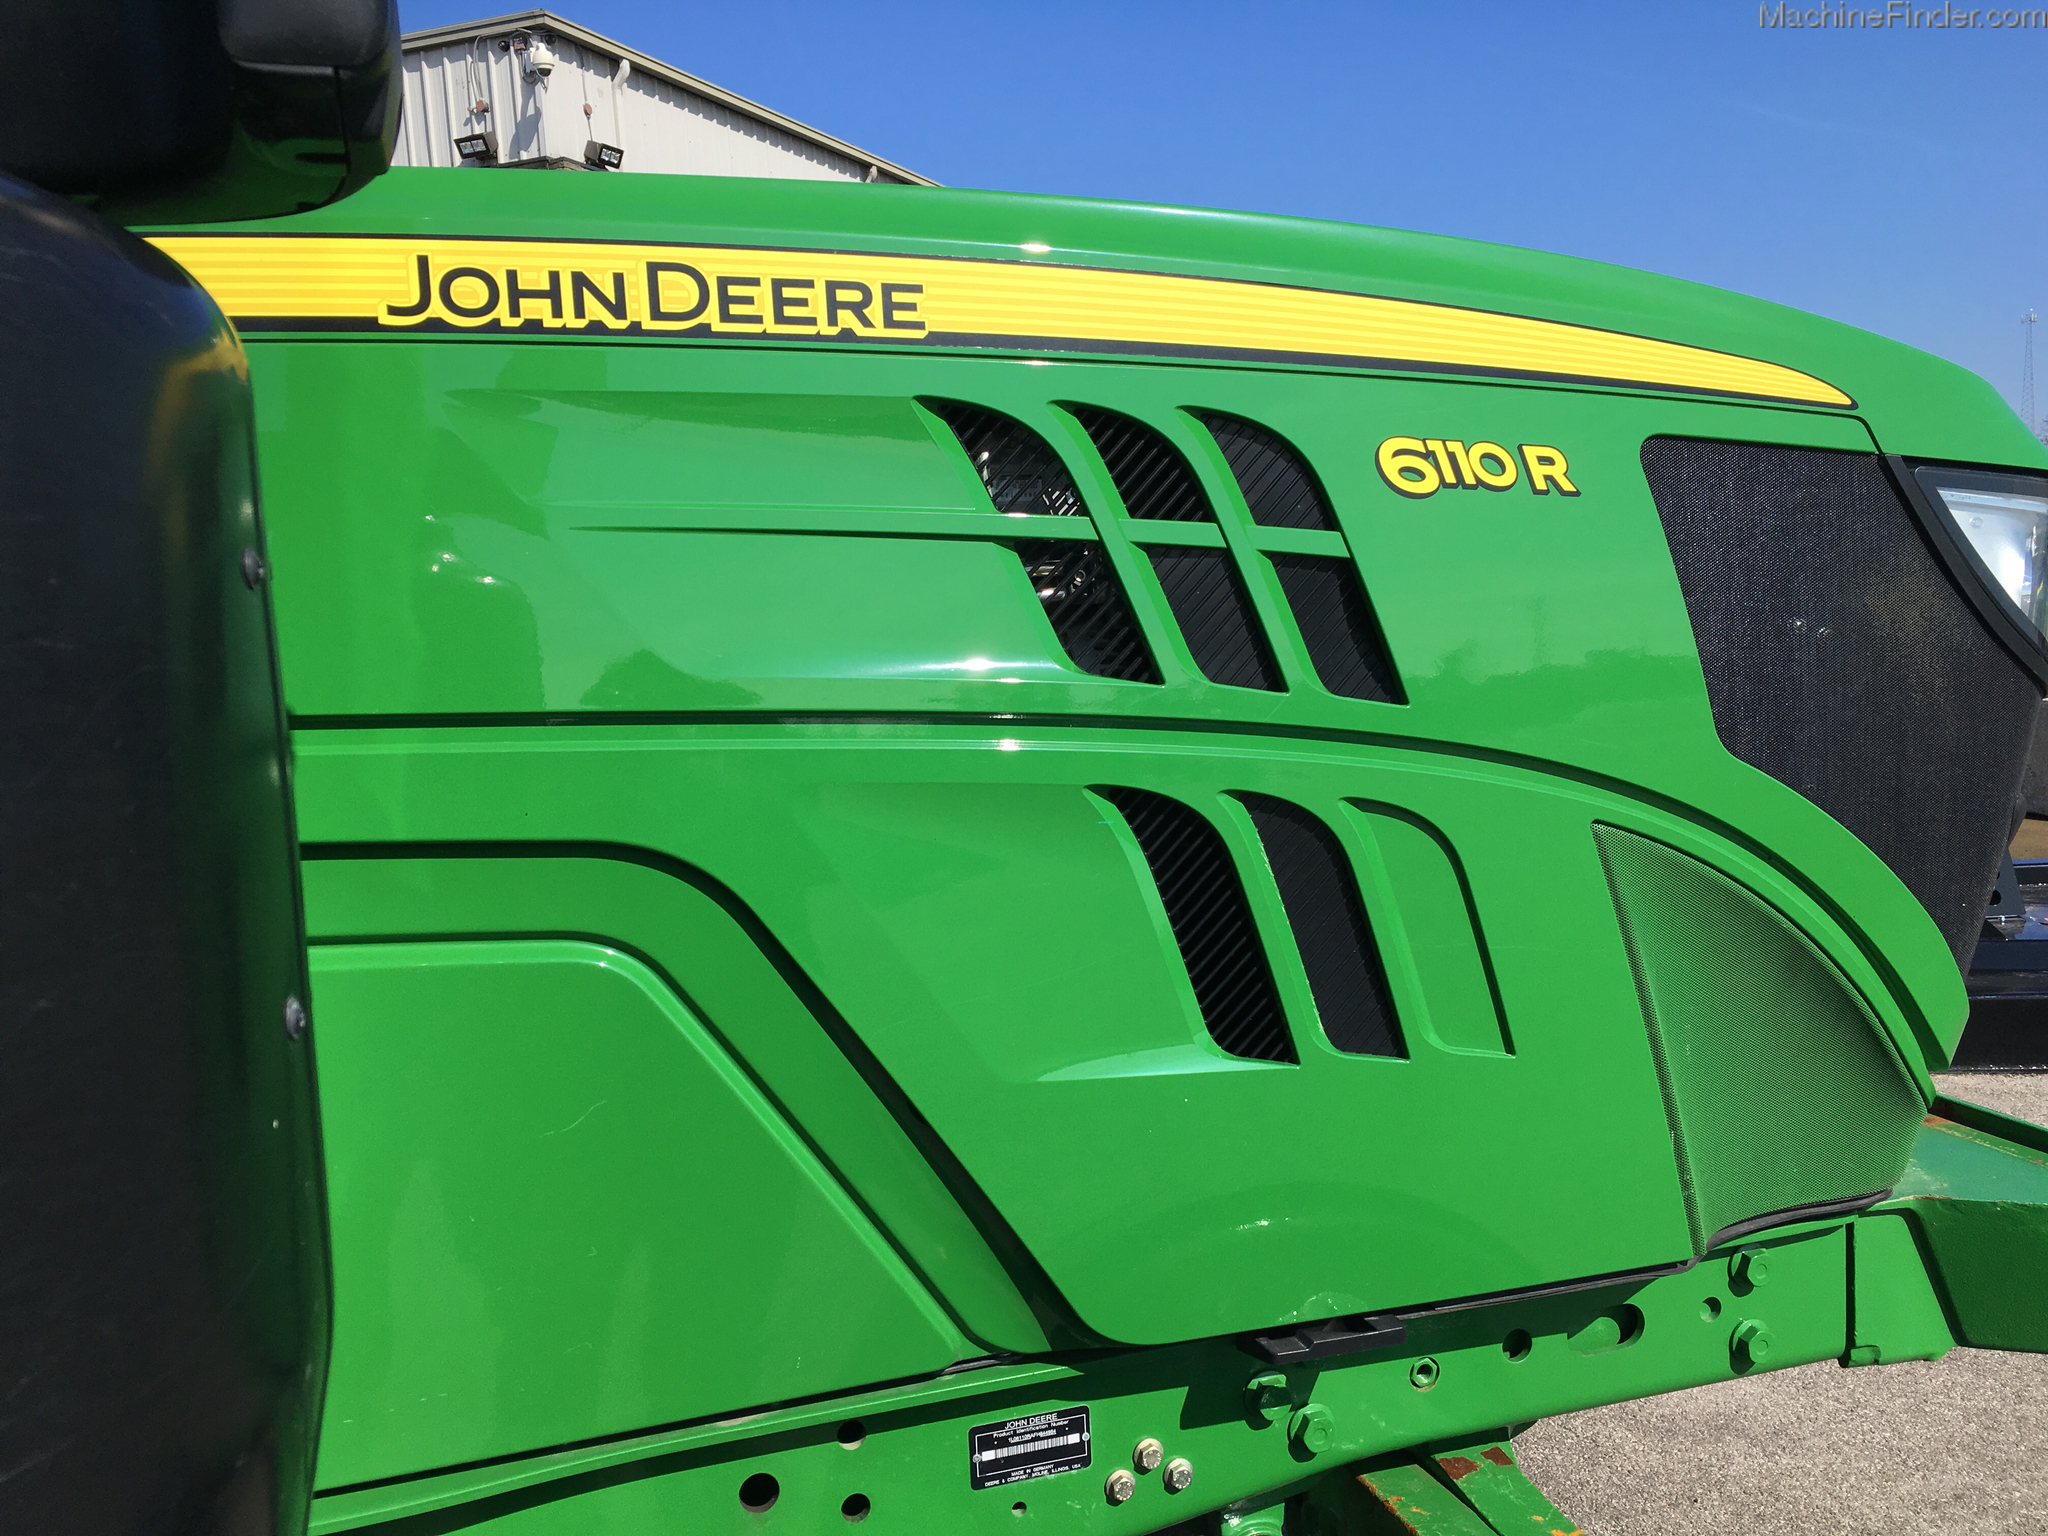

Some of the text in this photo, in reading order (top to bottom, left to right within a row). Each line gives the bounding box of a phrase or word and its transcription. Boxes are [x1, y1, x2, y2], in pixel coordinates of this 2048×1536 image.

[384, 253, 928, 332] JOHN DEERE
[1375, 435, 1582, 499] 6110 R
[1005, 1412, 1058, 1430] JOHN DEERE
[993, 1430, 1014, 1439] Product
[1016, 1423, 1048, 1434] Identification
[1011, 1469, 1025, 1477] MADE
[1033, 1464, 1054, 1473] GERMANY
